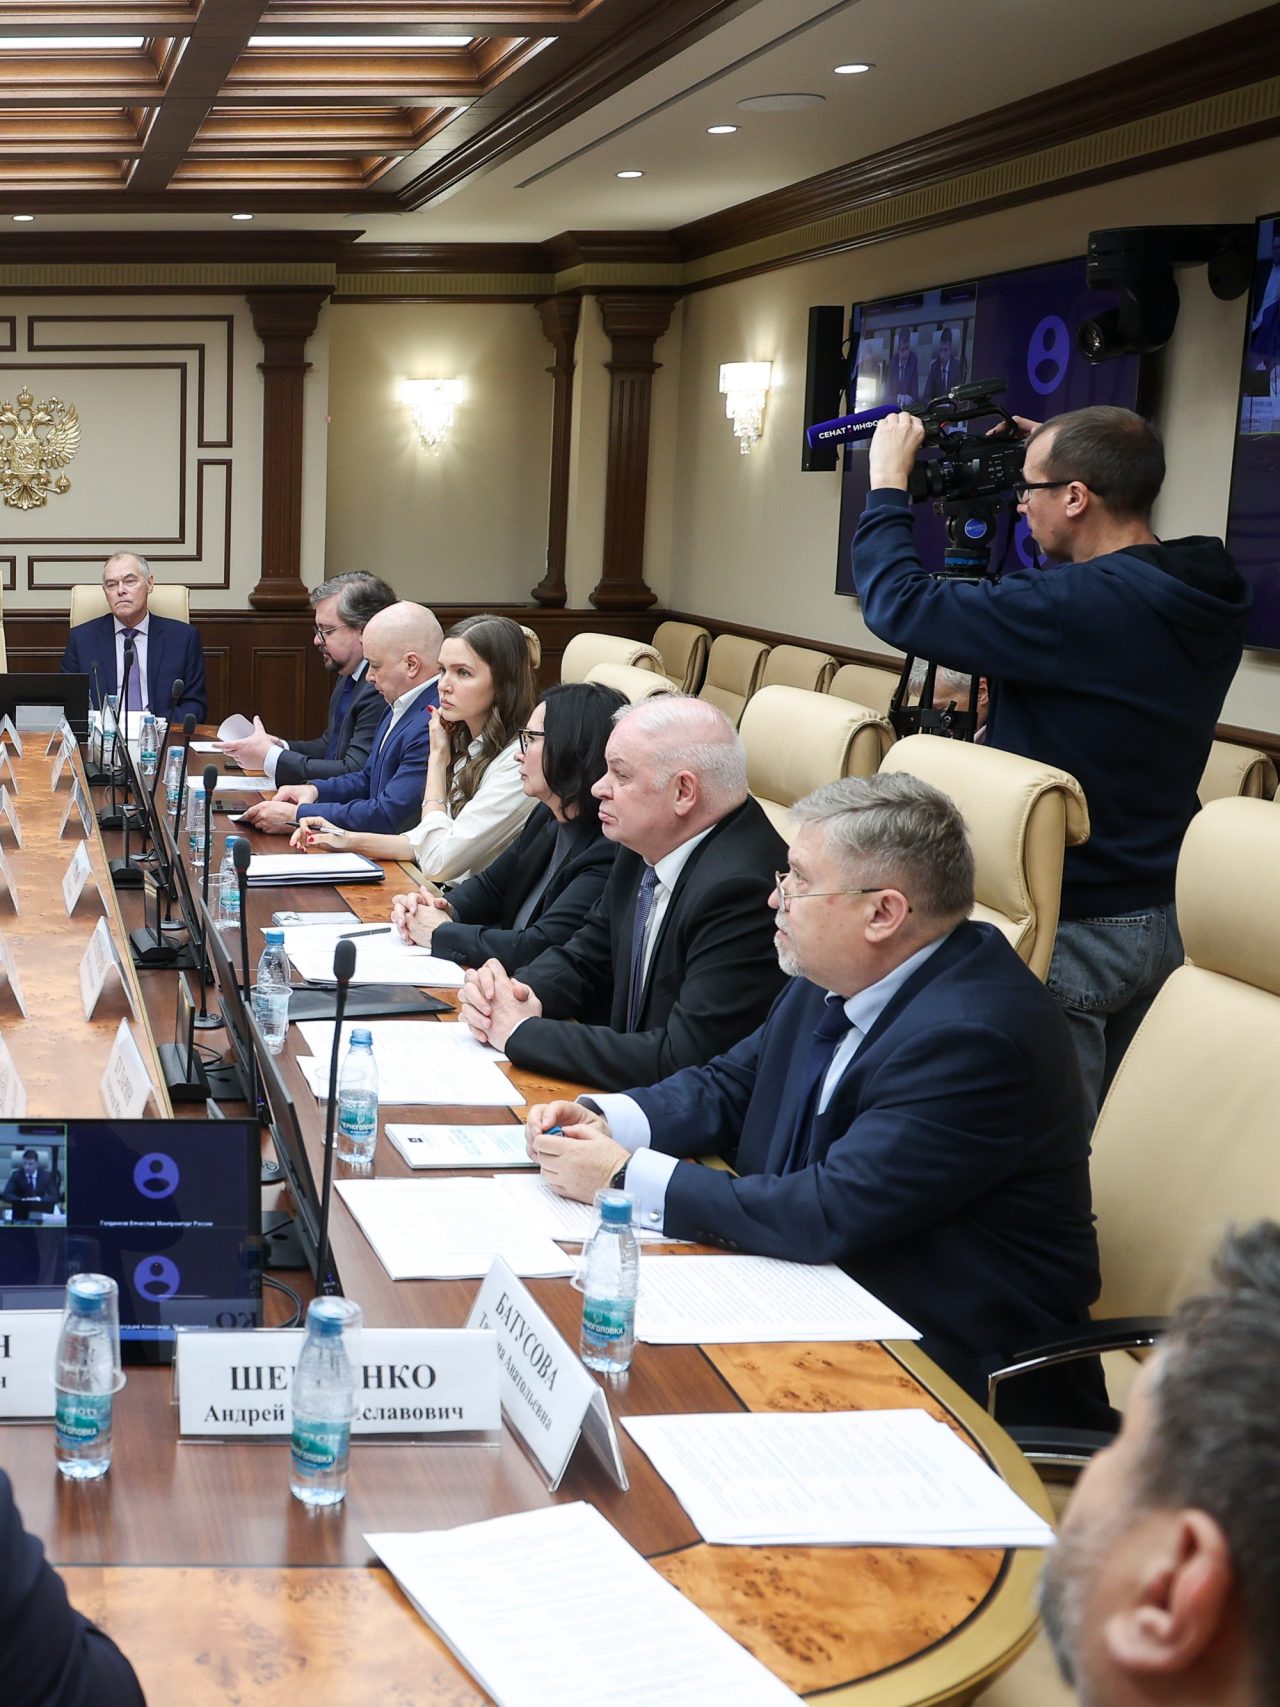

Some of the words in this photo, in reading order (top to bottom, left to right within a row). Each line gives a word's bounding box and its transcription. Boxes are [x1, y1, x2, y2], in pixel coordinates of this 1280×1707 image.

[818, 427, 847, 439] СЕНАТ
[495, 1292, 559, 1391] БАТУСОВА
[230, 1364, 437, 1391] ШЕНКО
[505, 1355, 552, 1432] Анатольевна
[204, 1404, 285, 1424] Андрей
[357, 1405, 464, 1422] славович
